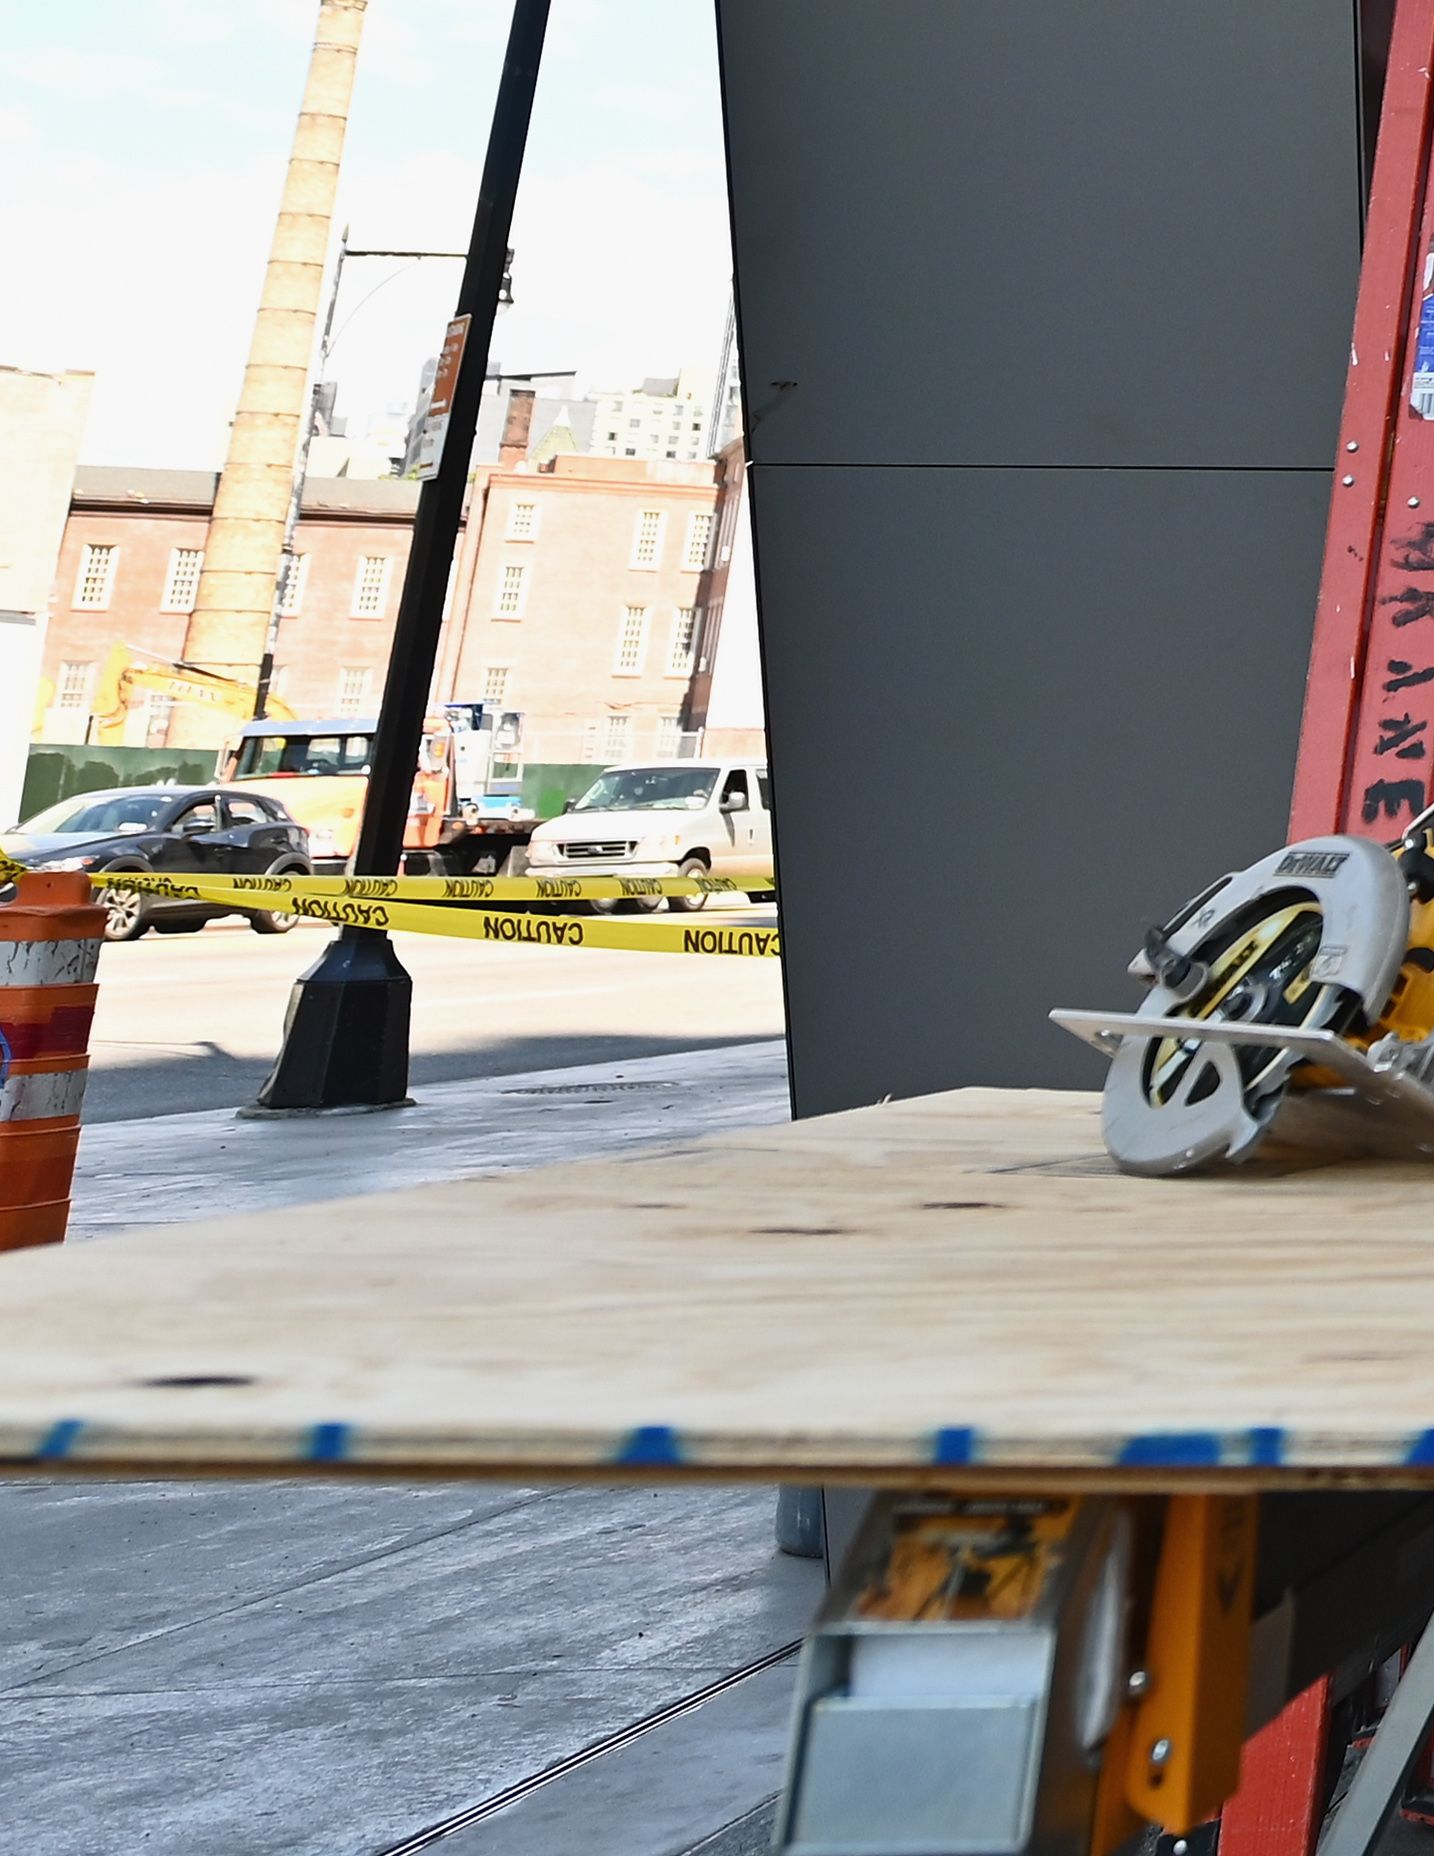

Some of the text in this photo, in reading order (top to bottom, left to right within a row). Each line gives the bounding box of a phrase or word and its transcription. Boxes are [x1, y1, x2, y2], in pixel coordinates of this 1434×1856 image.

[233, 878, 292, 892] CAUTION
[343, 879, 398, 897] CAUTION
[442, 879, 494, 898] CAUTION
[536, 879, 582, 898] CAUTION
[618, 878, 664, 895] CAUTION
[291, 897, 390, 926] CAUTION
[483, 916, 583, 946] CAUTION
[683, 929, 781, 956] CAUTION
